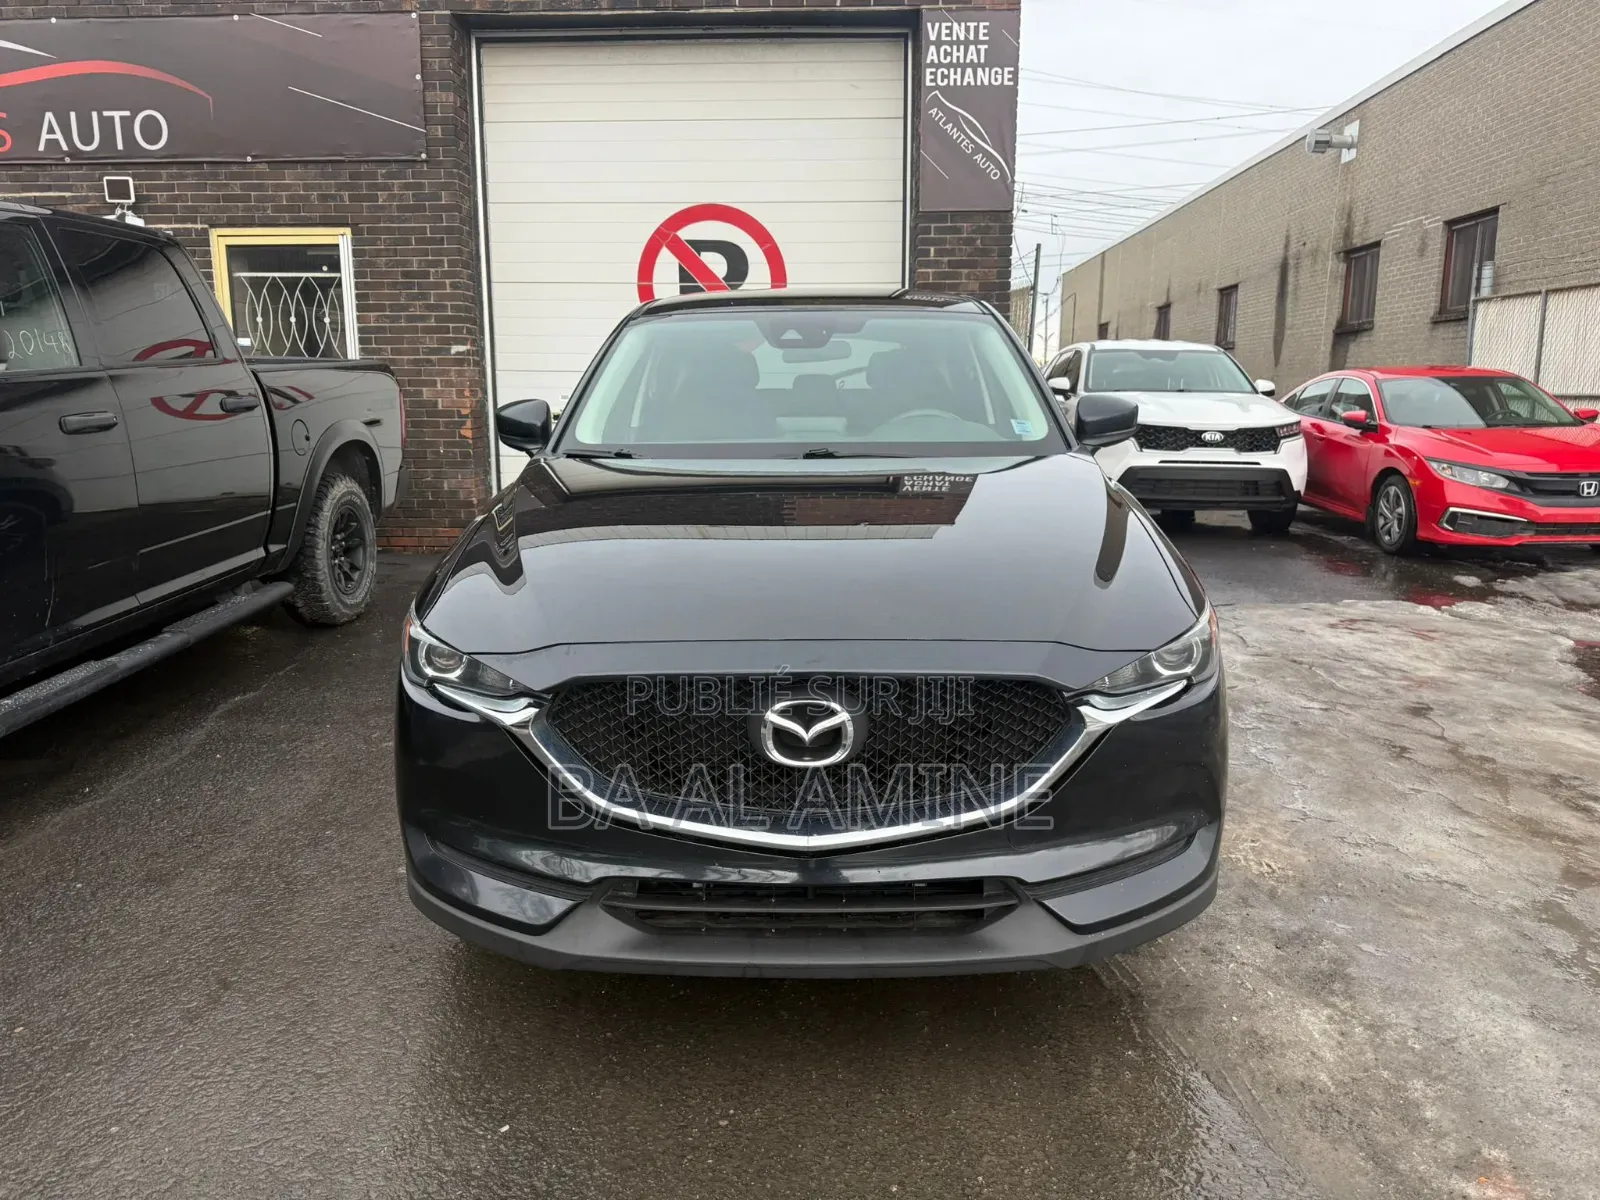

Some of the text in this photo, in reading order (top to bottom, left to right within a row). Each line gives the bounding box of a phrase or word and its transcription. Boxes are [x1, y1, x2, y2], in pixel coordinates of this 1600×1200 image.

[926, 22, 990, 41] VENTE
[925, 44, 989, 64] ACHAT
[925, 67, 1014, 87] ECHANGE
[38, 109, 169, 152] AUTO
[928, 107, 1001, 181] ATLANTES AUTO
